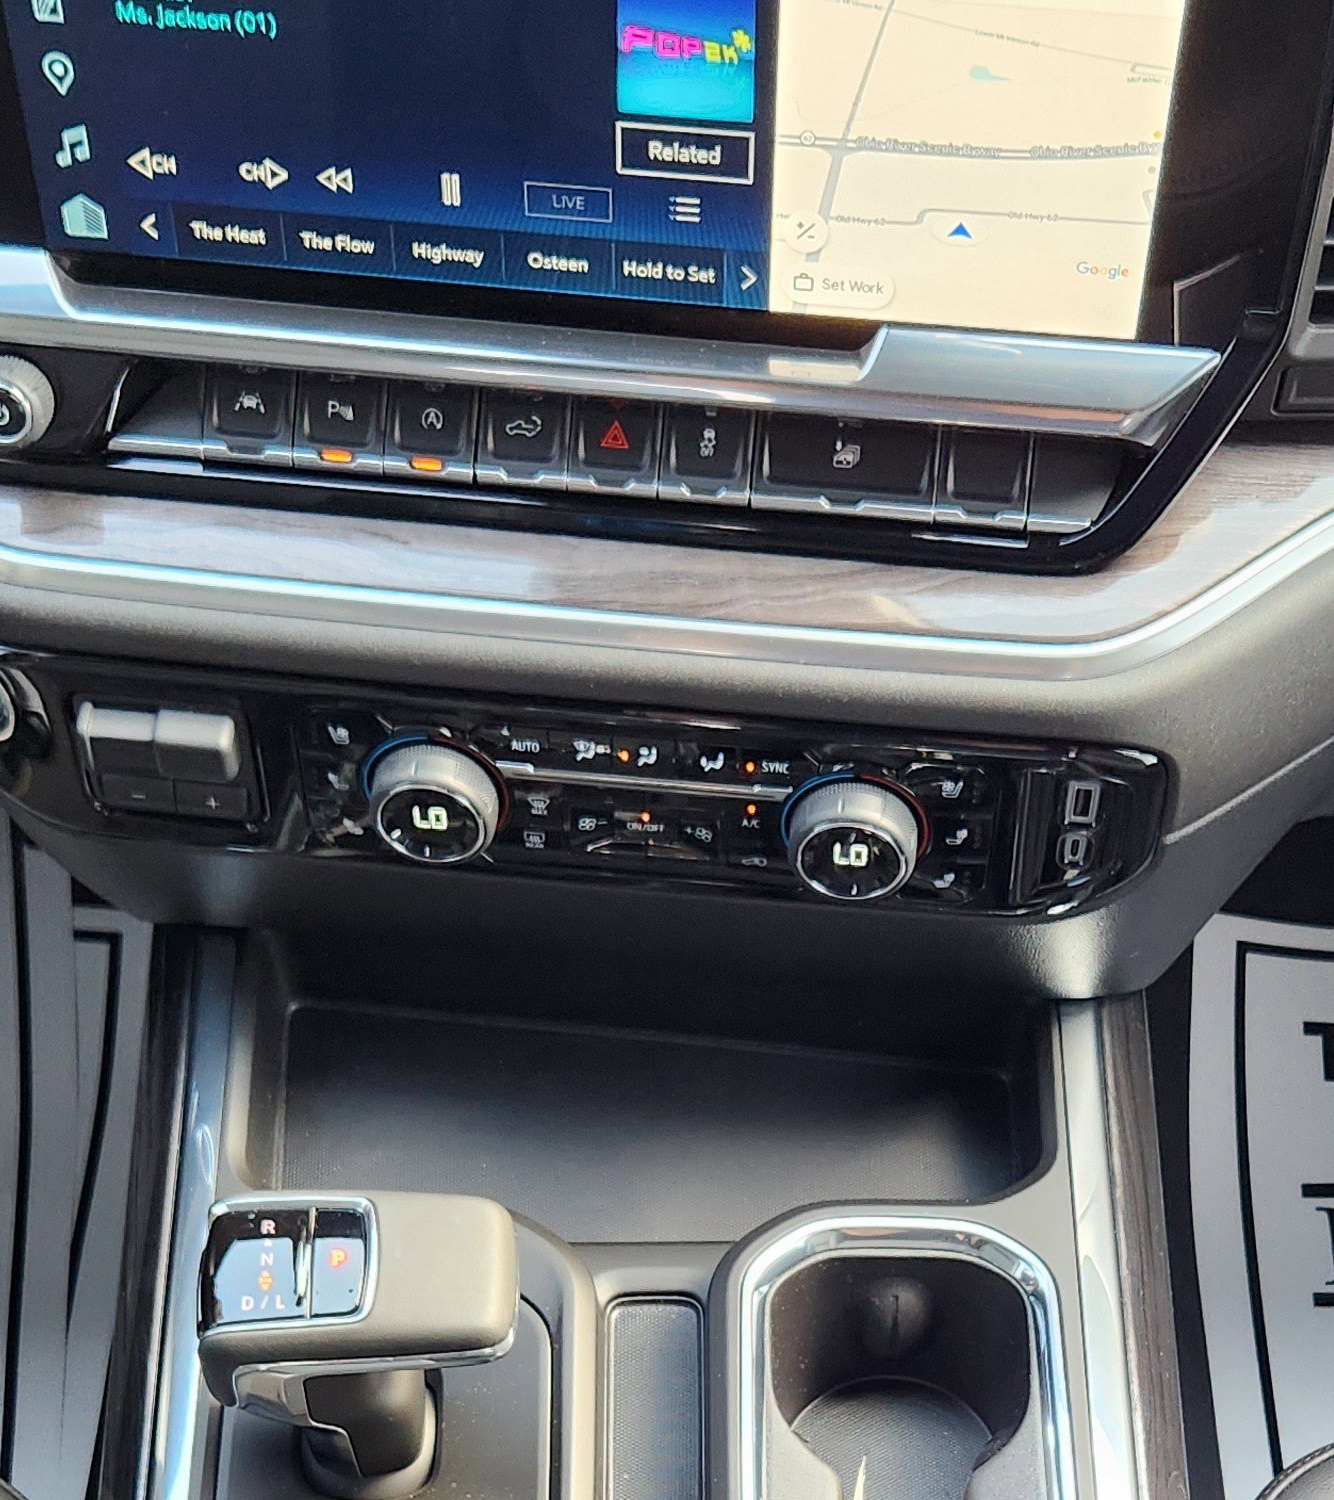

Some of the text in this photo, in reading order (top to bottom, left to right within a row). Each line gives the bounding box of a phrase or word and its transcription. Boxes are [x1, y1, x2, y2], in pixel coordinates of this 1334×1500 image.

[115, 0, 278, 40] Ms. Jackson (01)
[647, 139, 722, 166] Related
[886, 138, 916, 152] River
[919, 140, 960, 155] Scenic
[962, 143, 1001, 159] Byway
[1059, 145, 1092, 157] River
[1093, 142, 1137, 156] Scenic
[152, 153, 177, 175] CH
[551, 194, 586, 211] LIVE
[188, 219, 267, 246] The Heat
[298, 229, 376, 256] The Flow
[411, 241, 485, 269] Highway
[526, 251, 589, 274] Osteen
[622, 260, 717, 285] Hold to Set
[1076, 261, 1130, 280] Google
[821, 277, 884, 296] Set Work
[510, 738, 541, 755] AUTO
[760, 760, 791, 775] SYNC
[740, 817, 761, 830] A/C
[260, 1219, 276, 1235] R
[260, 1253, 274, 1266] N
[330, 1249, 348, 1268] P
